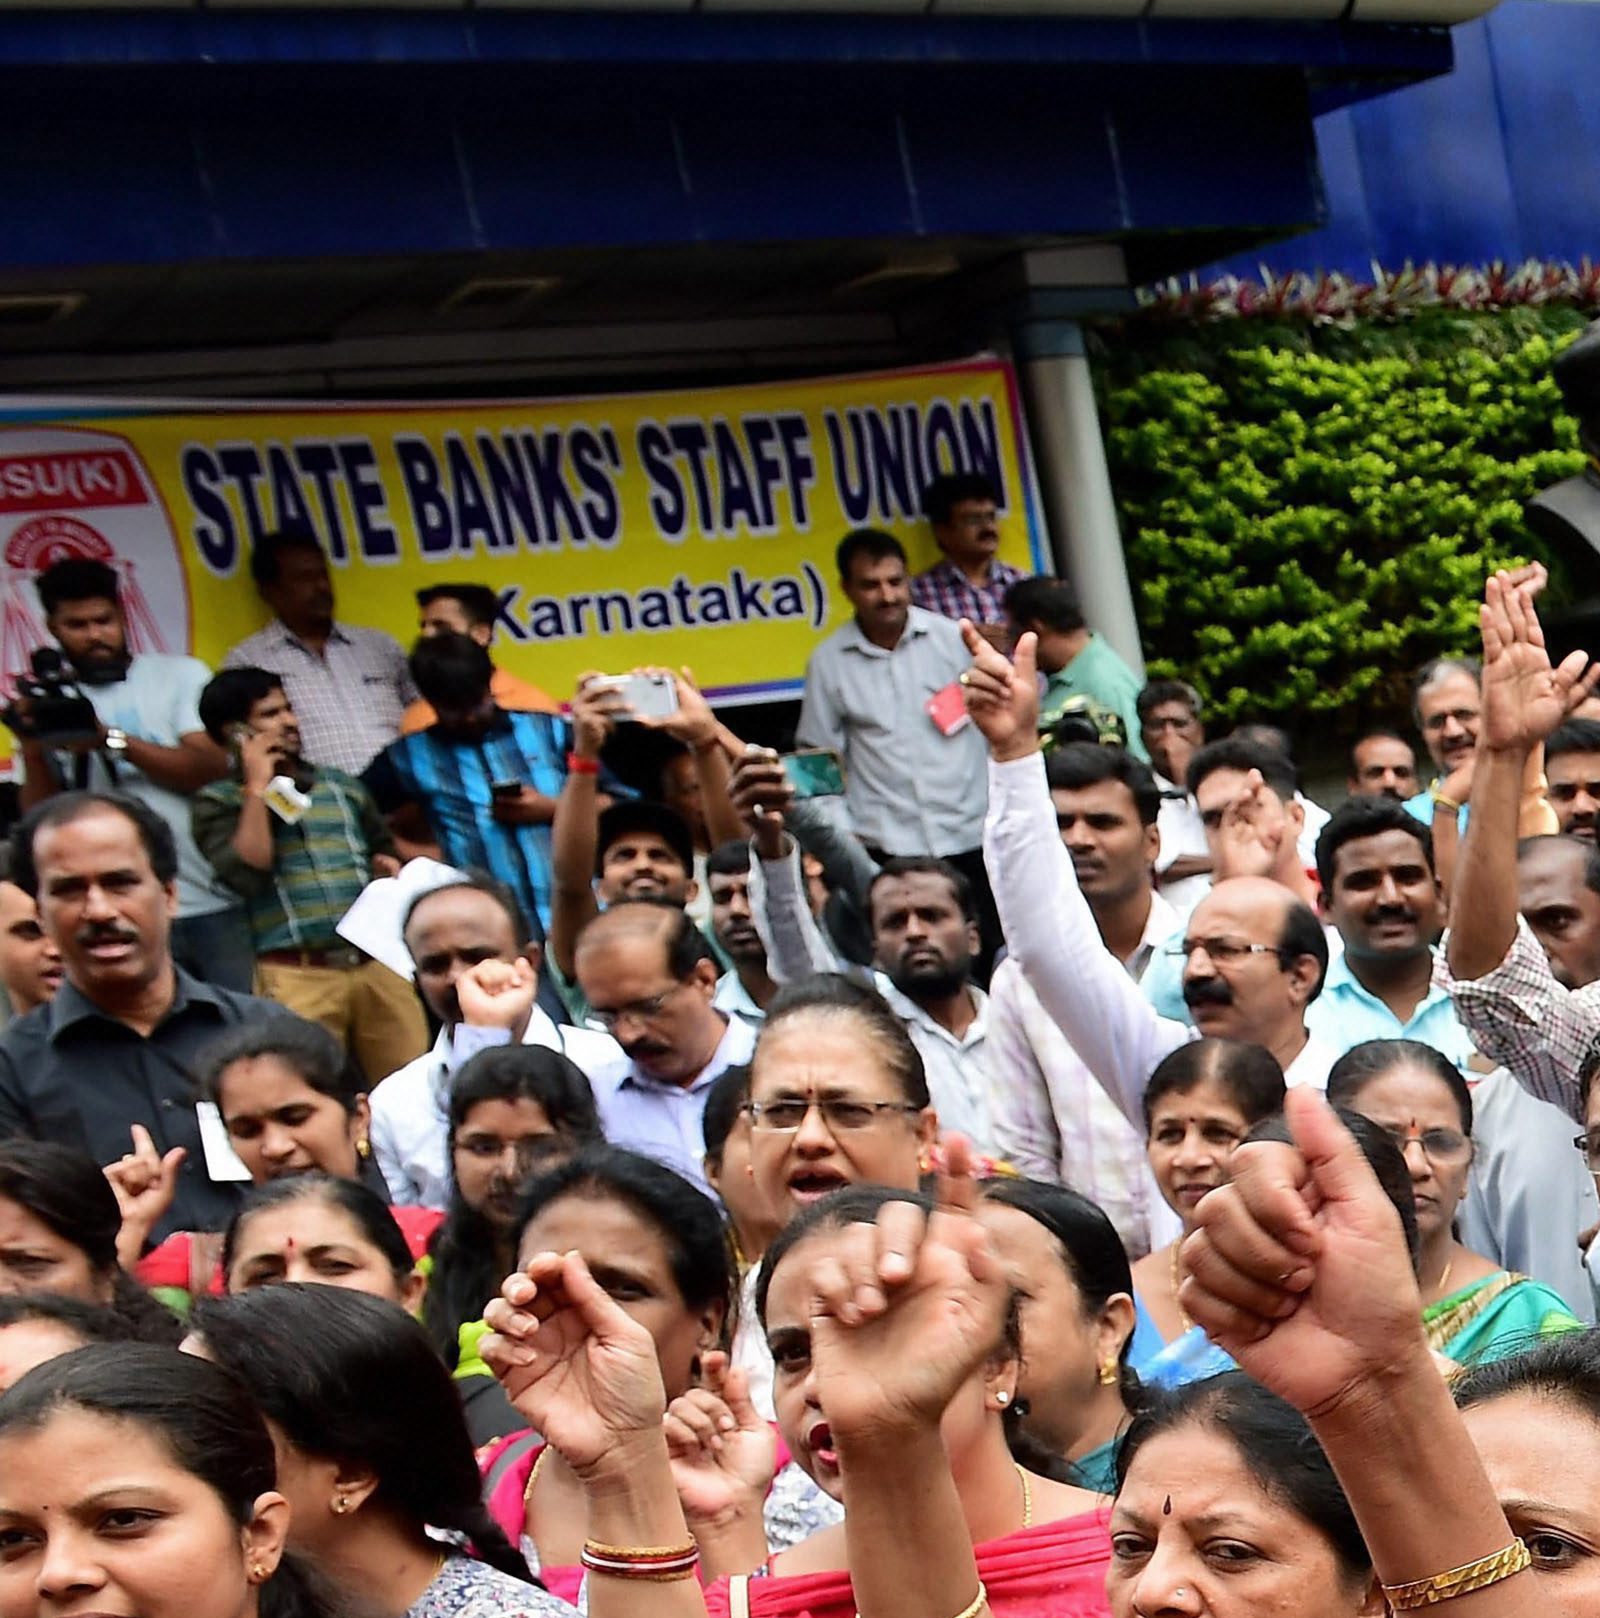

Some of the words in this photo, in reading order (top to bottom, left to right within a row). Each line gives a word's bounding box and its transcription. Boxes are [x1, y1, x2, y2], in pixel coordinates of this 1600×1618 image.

[0, 458, 127, 500] SU(K)
[183, 440, 398, 571] STATE
[394, 427, 621, 553] BANKS'
[637, 413, 814, 535] STAFF
[825, 401, 1007, 522] UNION
[495, 562, 824, 641] Karnataka)
